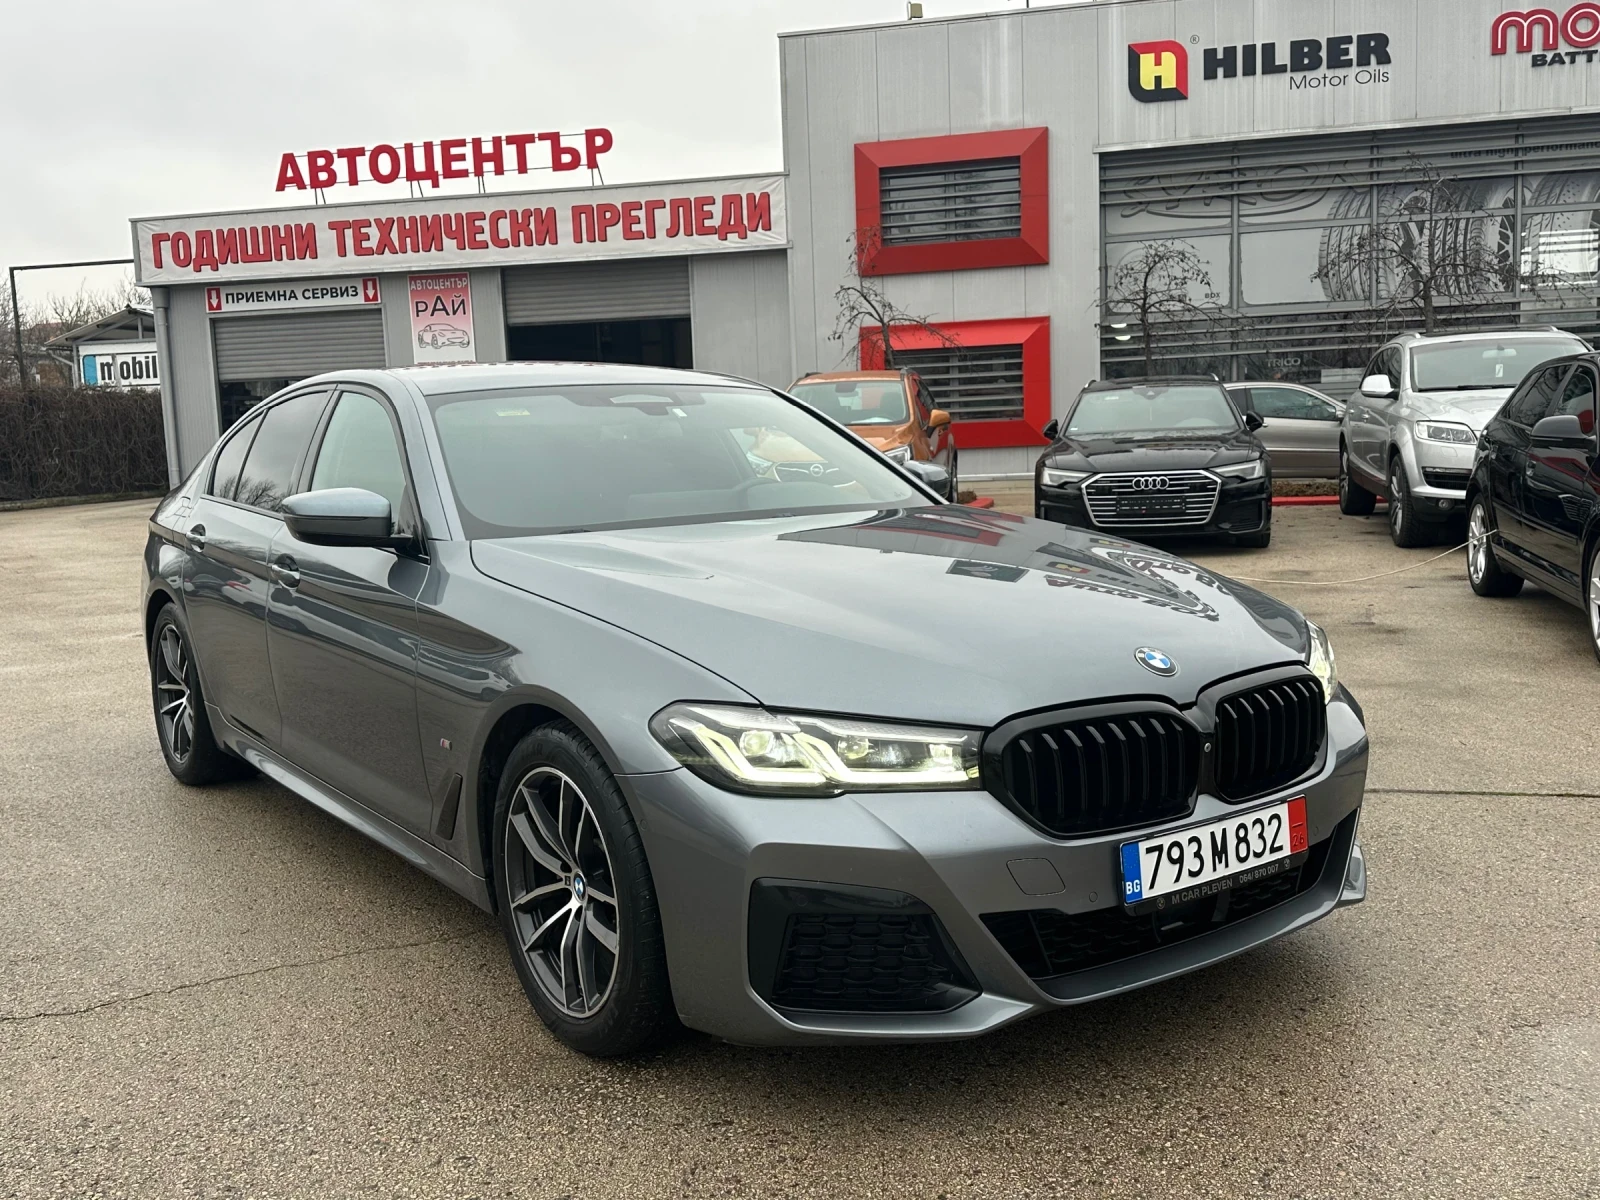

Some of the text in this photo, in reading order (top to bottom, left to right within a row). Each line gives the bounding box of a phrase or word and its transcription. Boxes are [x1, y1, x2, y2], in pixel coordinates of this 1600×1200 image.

[1203, 33, 1391, 80] HILBER
[1531, 49, 1600, 67] BATT
[1289, 69, 1390, 90] Motor Oils
[276, 128, 613, 191] АВТОЦЕНТЪР
[151, 192, 771, 272] ГОДИШНИ ТЕХНИЧЕСКИ ПРЕГЛЕДИ
[410, 277, 468, 291] АВТОЦЕНТЪР
[225, 285, 359, 304] ПРИЕМНА СЕРВИЗ
[1267, 357, 1300, 367] TRICO
[1292, 832, 1305, 847] 26
[1146, 813, 1284, 891] 793 M 832
[1126, 879, 1141, 895] BG
[1171, 894, 1180, 904] M
[1181, 888, 1200, 902] CAR
[1201, 878, 1233, 896] PLEVEN
[1267, 863, 1279, 875] 007
